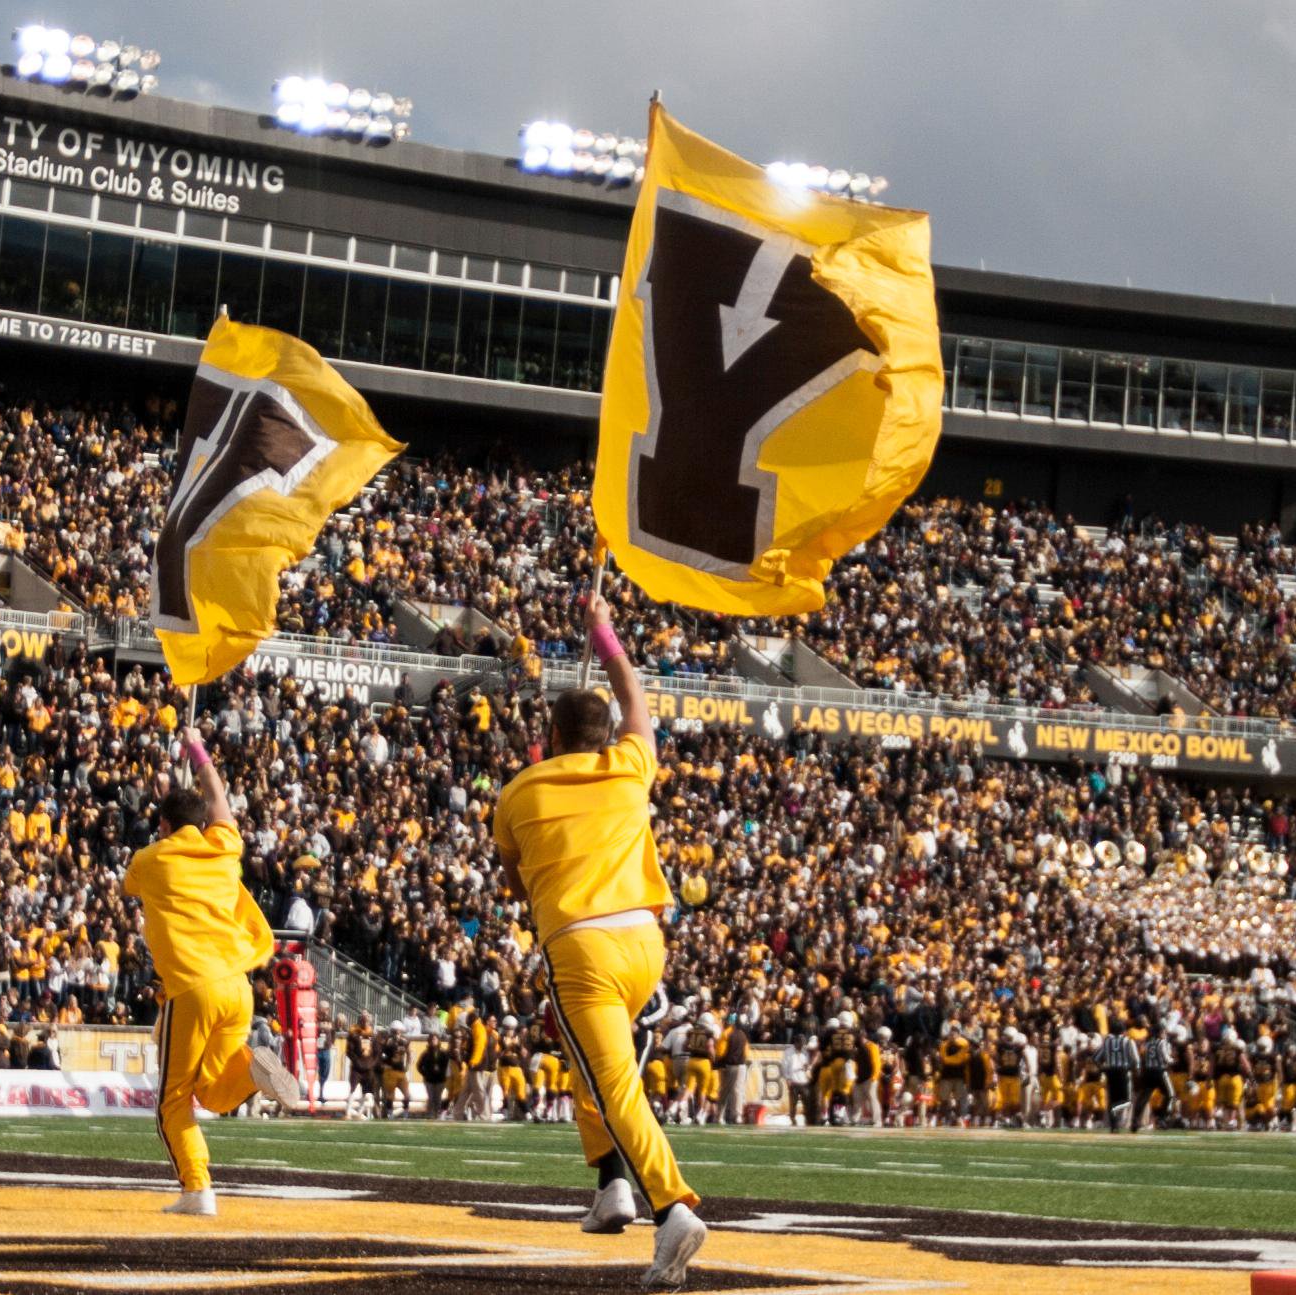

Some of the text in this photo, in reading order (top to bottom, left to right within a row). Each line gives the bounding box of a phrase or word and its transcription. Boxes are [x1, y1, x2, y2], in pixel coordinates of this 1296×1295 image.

[57, 128, 104, 160] OF
[115, 137, 285, 194] WYOMING
[90, 165, 142, 196] Club
[147, 176, 165, 202] &
[170, 180, 240, 214] Suites
[28, 320, 53, 341] TO
[59, 326, 103, 348] 7220
[107, 333, 157, 356] FEET
[627, 187, 883, 583] Y
[683, 695, 754, 725] BOWL
[792, 704, 1000, 744] LAS VEGAS BOWL
[881, 734, 912, 750] 2004
[1036, 724, 1253, 763] NEW MEXICO BOWL
